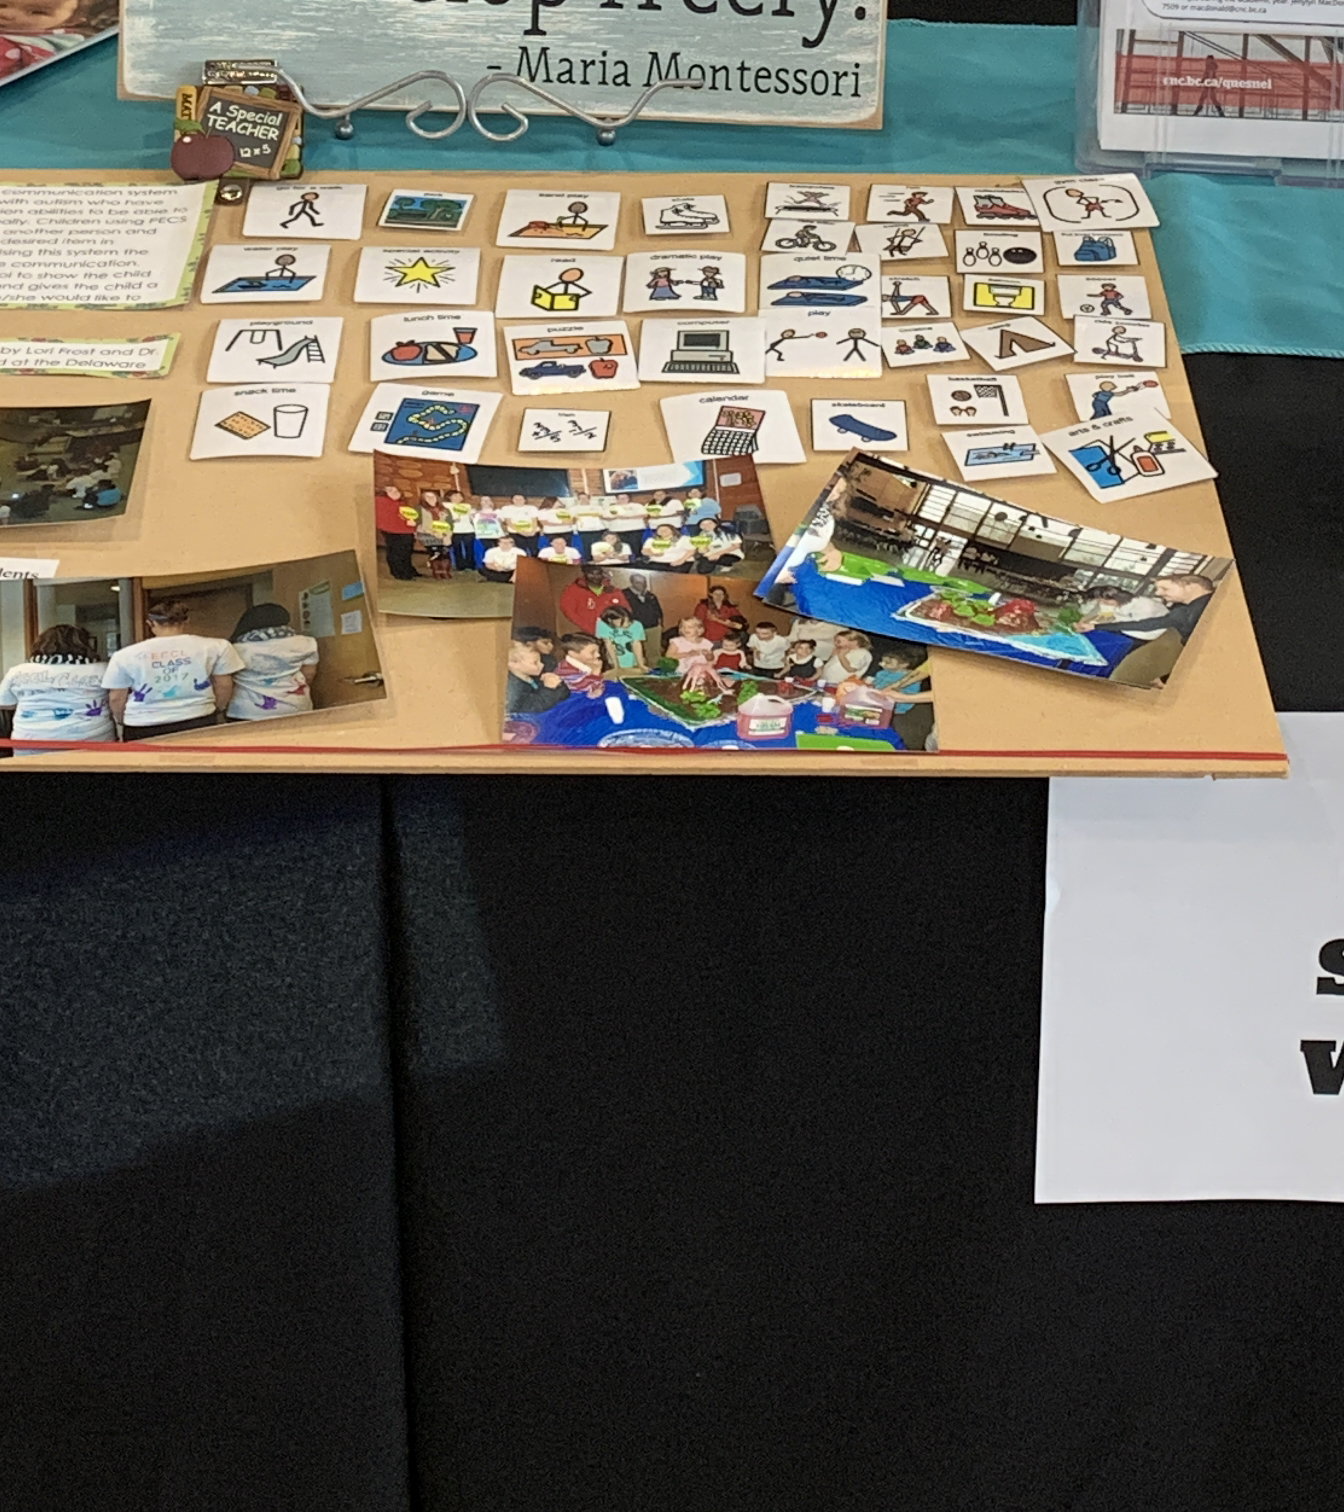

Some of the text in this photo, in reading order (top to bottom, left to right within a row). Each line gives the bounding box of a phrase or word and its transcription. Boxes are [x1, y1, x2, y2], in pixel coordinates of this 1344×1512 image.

[516, 46, 862, 97] Maria Montessori
[207, 114, 279, 141] TEACHER
[209, 102, 283, 126] A Special
